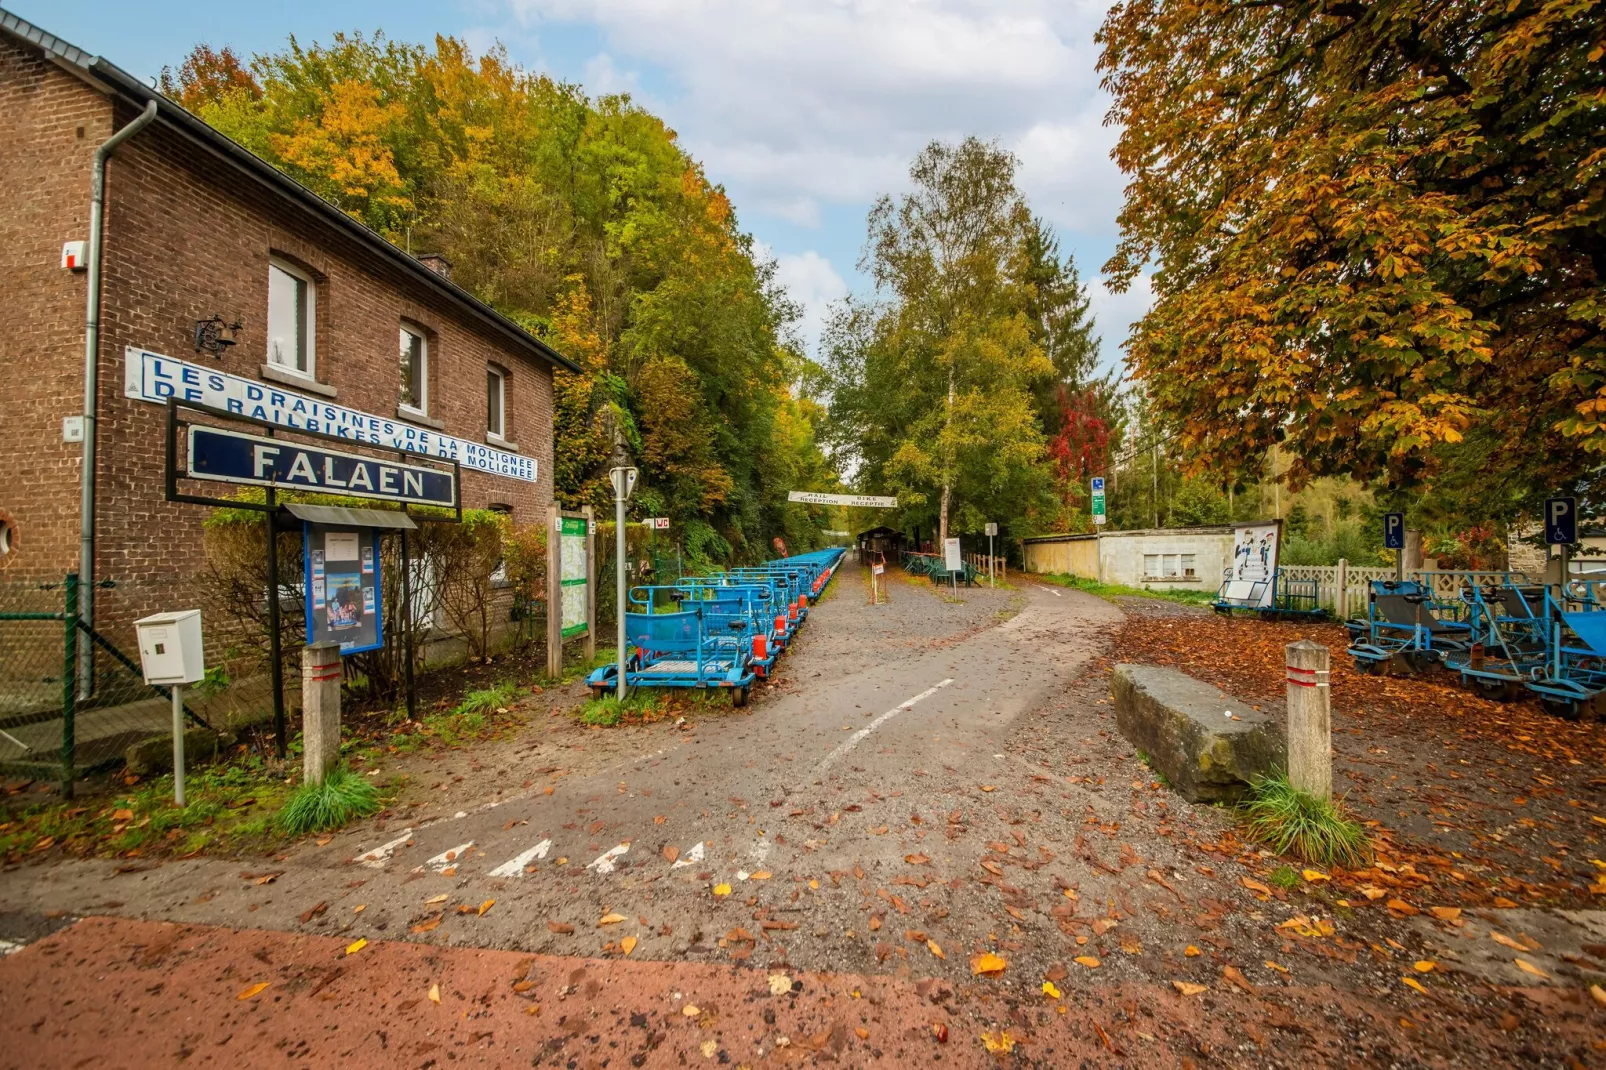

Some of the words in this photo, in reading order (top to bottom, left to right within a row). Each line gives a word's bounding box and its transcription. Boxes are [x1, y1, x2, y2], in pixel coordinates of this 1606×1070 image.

[154, 360, 225, 392] LES
[247, 385, 394, 435] DRAISINES
[406, 428, 429, 443] DE
[439, 437, 458, 451] LA
[466, 444, 532, 469] MOLIGNEE
[154, 380, 203, 403] DE
[227, 397, 380, 445] RAILBIKES
[393, 438, 428, 455] VAN
[439, 449, 457, 460] DE
[467, 455, 532, 479] MOLIGNEE
[253, 444, 424, 497] FALAEN
[800, 497, 839, 505] RECEPTION
[1551, 501, 1569, 526] P
[656, 519, 668, 527] WC
[1388, 515, 1399, 535] P
